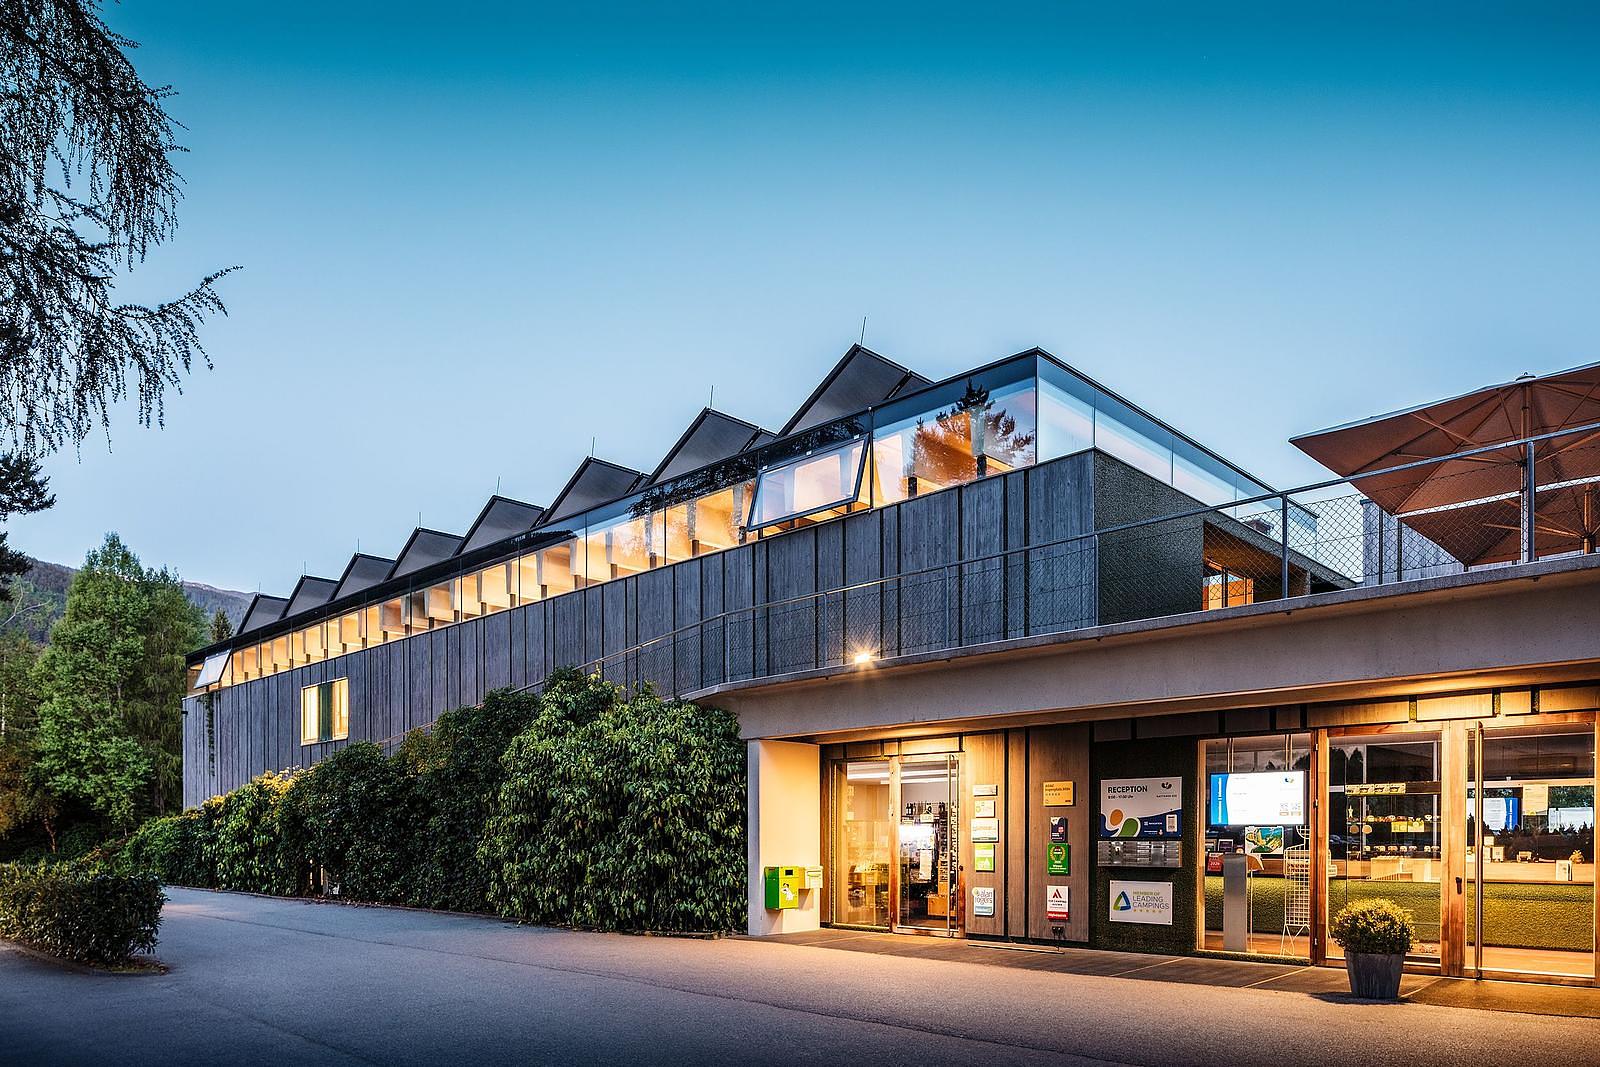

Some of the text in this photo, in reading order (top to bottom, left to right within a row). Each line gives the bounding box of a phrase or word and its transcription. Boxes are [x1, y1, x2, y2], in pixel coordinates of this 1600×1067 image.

[1108, 785, 1148, 793] RECEPTION
[1133, 895, 1164, 903] LEADING
[1133, 902, 1170, 910] CAMPINGS
